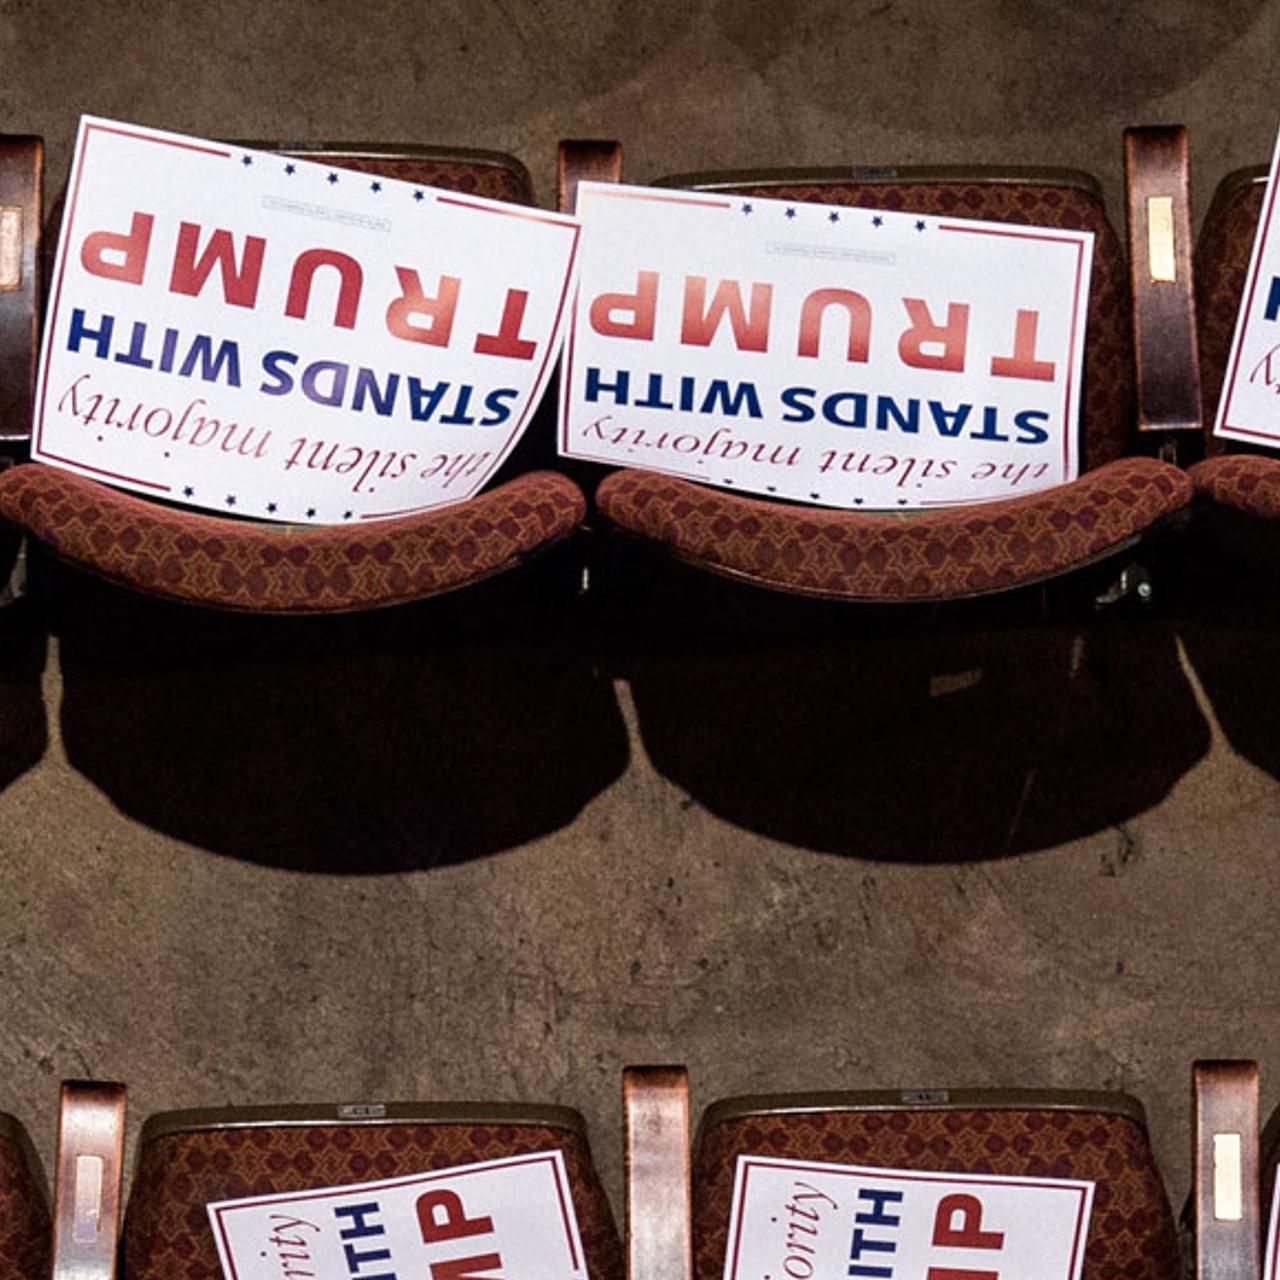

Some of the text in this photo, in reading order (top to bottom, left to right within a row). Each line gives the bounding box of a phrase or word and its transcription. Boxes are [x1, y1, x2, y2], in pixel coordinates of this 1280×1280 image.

[80, 211, 538, 361] TRUMP
[588, 270, 1057, 382] TRUMP
[66, 308, 519, 427] STANDS WITH
[584, 367, 1051, 445] STANDS WITH
[58, 374, 492, 493] the silent majority
[582, 415, 802, 467] majority
[819, 449, 958, 489] silent
